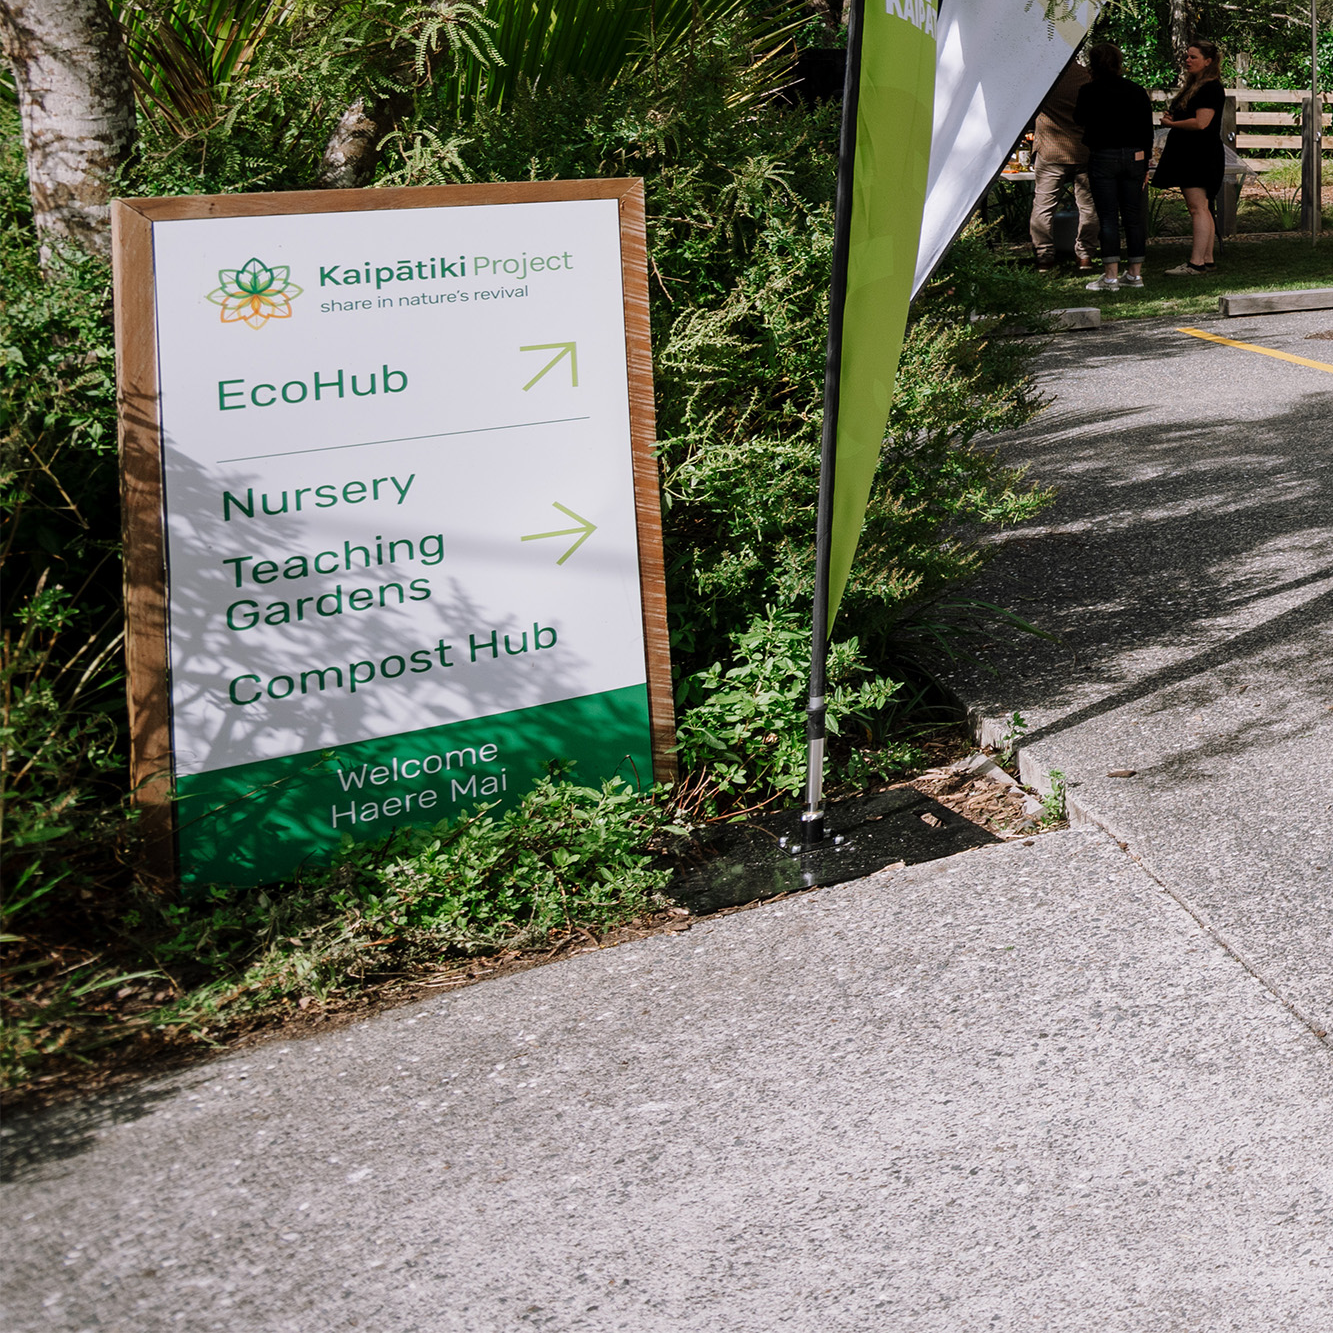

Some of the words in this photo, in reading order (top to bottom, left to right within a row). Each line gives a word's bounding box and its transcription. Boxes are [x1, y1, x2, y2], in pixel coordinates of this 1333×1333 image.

[319, 255, 467, 290] Kaipātiki
[473, 251, 574, 280] Project
[320, 299, 373, 313] share
[377, 295, 393, 308] in
[398, 290, 470, 307] nature's
[473, 285, 529, 301] revival
[217, 364, 408, 410] EcoHub
[223, 472, 417, 522] Nursery
[223, 530, 445, 588] Teaching
[225, 577, 432, 632] Gardens
[228, 639, 454, 707] Compost
[469, 621, 558, 663] Hub
[335, 742, 500, 792] Welcome
[330, 783, 439, 830] Haere
[450, 768, 508, 802] Mai
